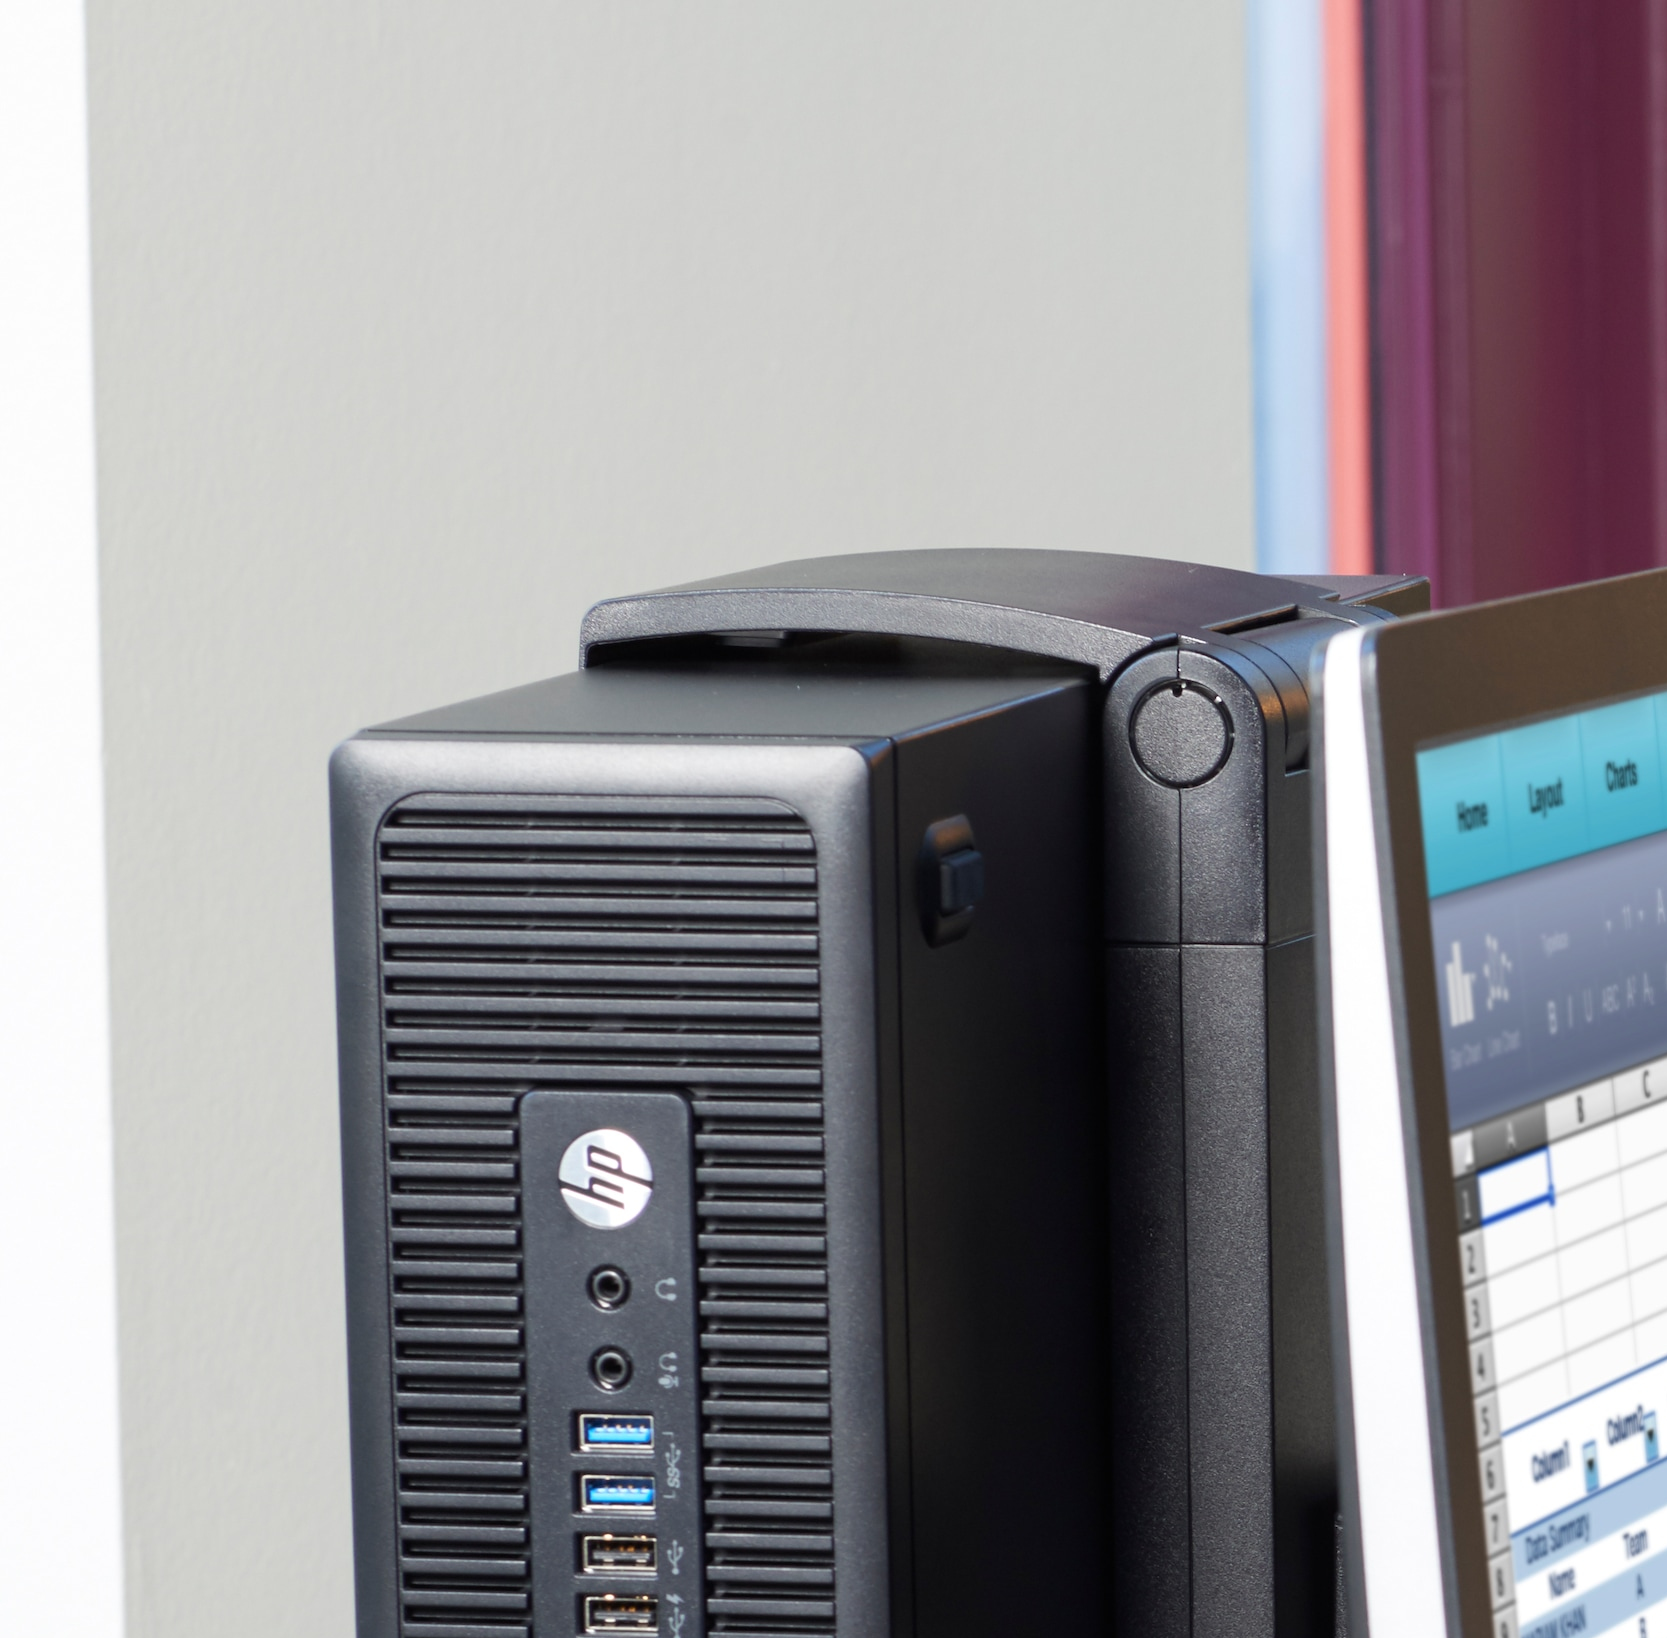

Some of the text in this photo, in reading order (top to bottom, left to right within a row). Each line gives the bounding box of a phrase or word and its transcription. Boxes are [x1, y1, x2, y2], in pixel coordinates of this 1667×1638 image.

[1606, 760, 1638, 792] Charts
[1457, 801, 1488, 832] Home
[1528, 778, 1564, 818] Layout
[1643, 1069, 1651, 1098] C
[559, 1133, 653, 1224] hp
[1532, 1441, 1570, 1483] Column1
[1607, 1405, 1645, 1446] Column2
[1525, 1512, 1590, 1565] Data Summary
[1549, 1568, 1576, 1599] Name
[1623, 1529, 1648, 1560] Team
[1636, 1574, 1645, 1599] A
